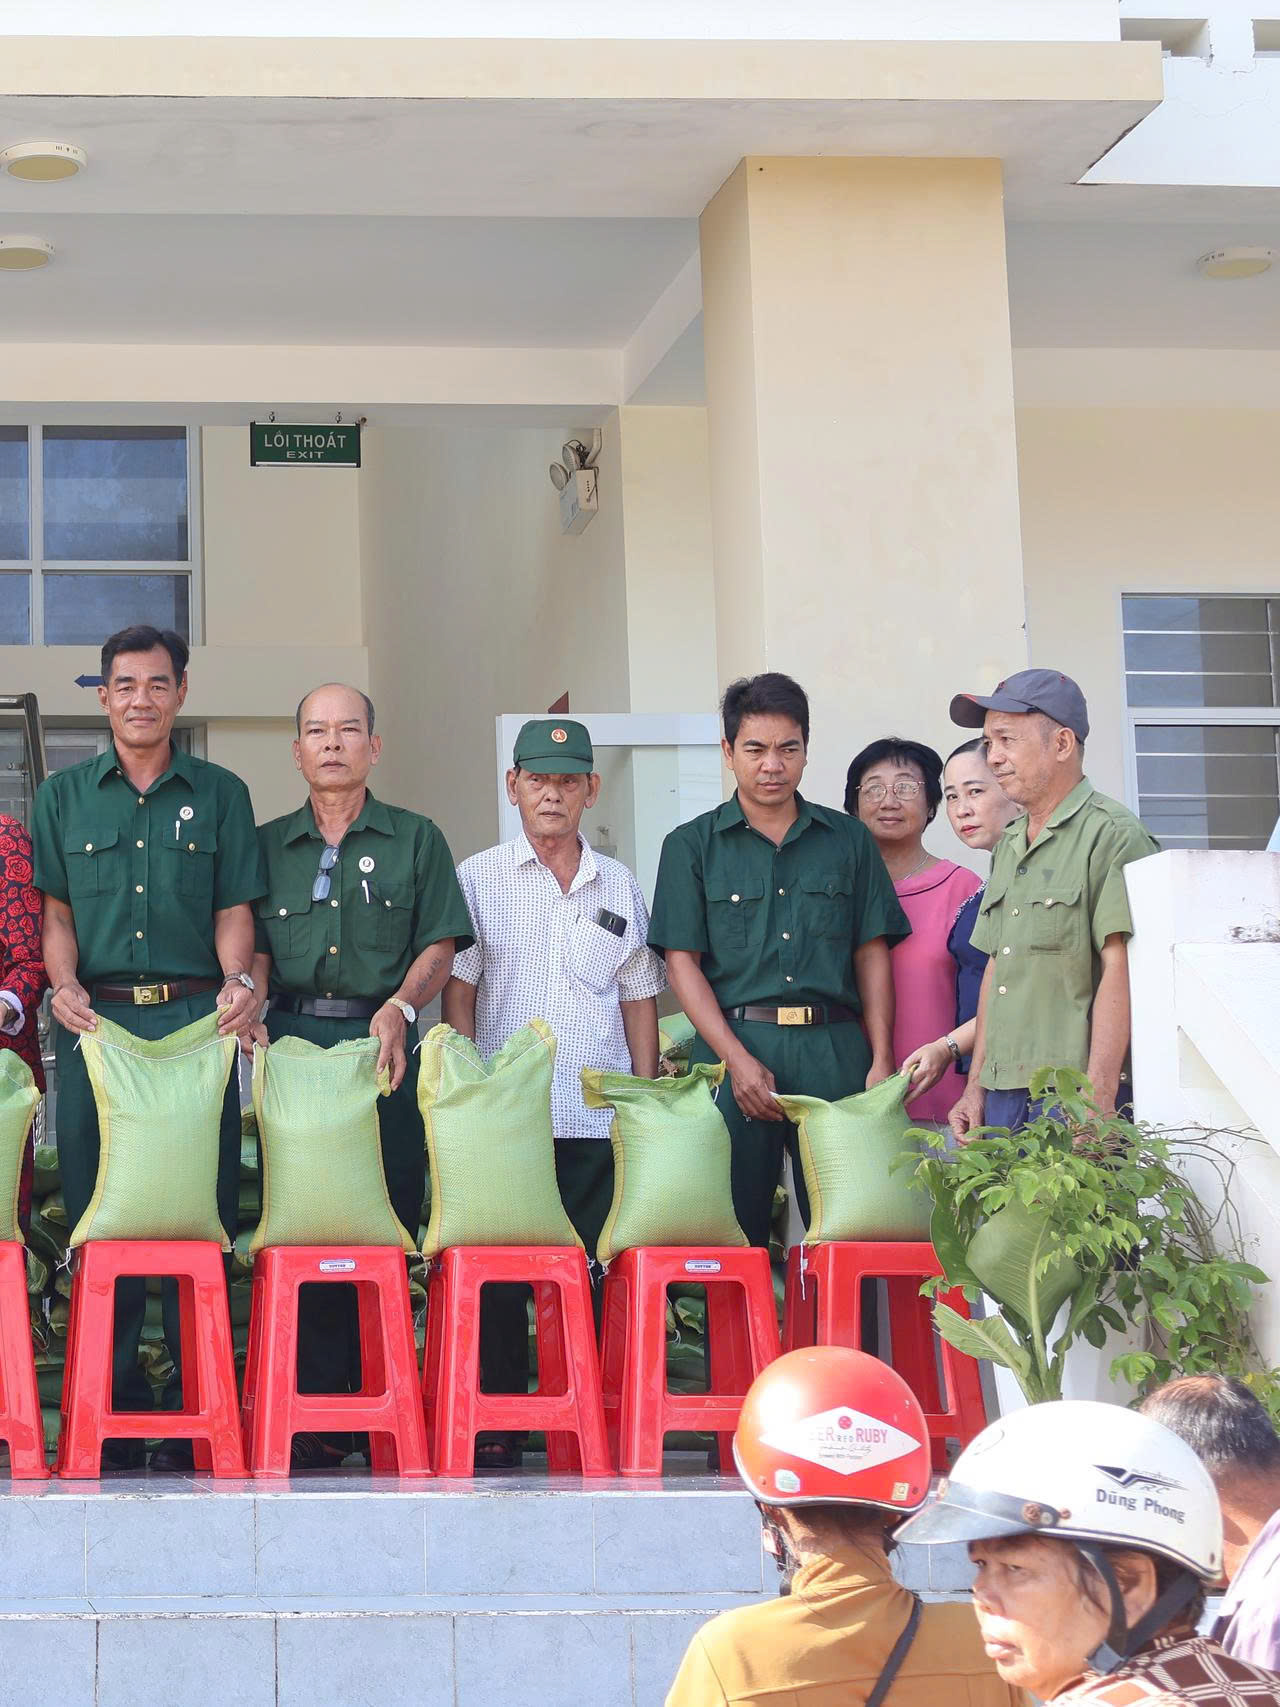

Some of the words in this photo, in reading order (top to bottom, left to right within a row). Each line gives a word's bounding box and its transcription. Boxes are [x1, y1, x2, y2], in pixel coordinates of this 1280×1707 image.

[293, 431, 347, 449] THOÁT
[286, 451, 325, 459] EXIT
[855, 1427, 889, 1444] RUBY
[1144, 1497, 1186, 1525] Phong
